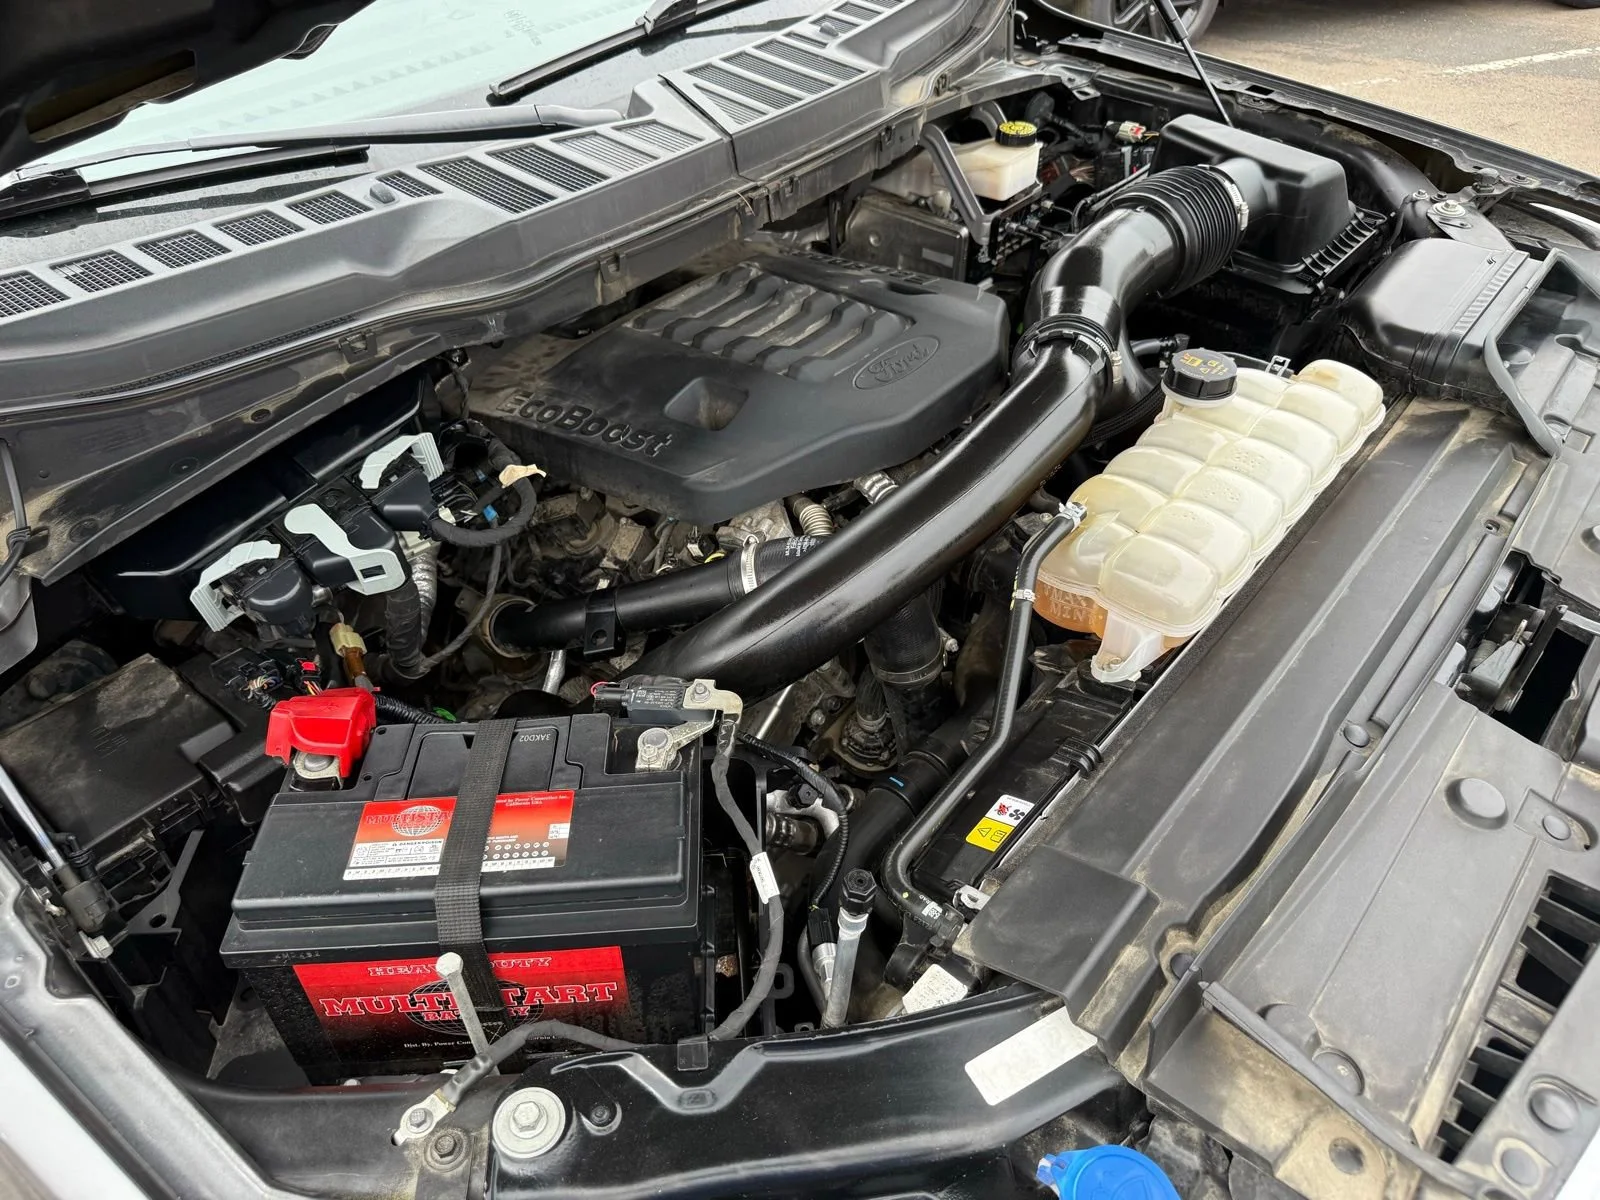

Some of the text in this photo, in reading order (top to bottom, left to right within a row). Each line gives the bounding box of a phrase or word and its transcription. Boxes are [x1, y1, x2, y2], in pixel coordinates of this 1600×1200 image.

[497, 388, 673, 457] EcoBoost
[1051, 601, 1086, 621] MIN
[519, 733, 551, 742] 3AKD02
[366, 811, 456, 824] MULTISTA
[368, 963, 438, 976] HEA
[319, 982, 618, 1016] MULTITART
